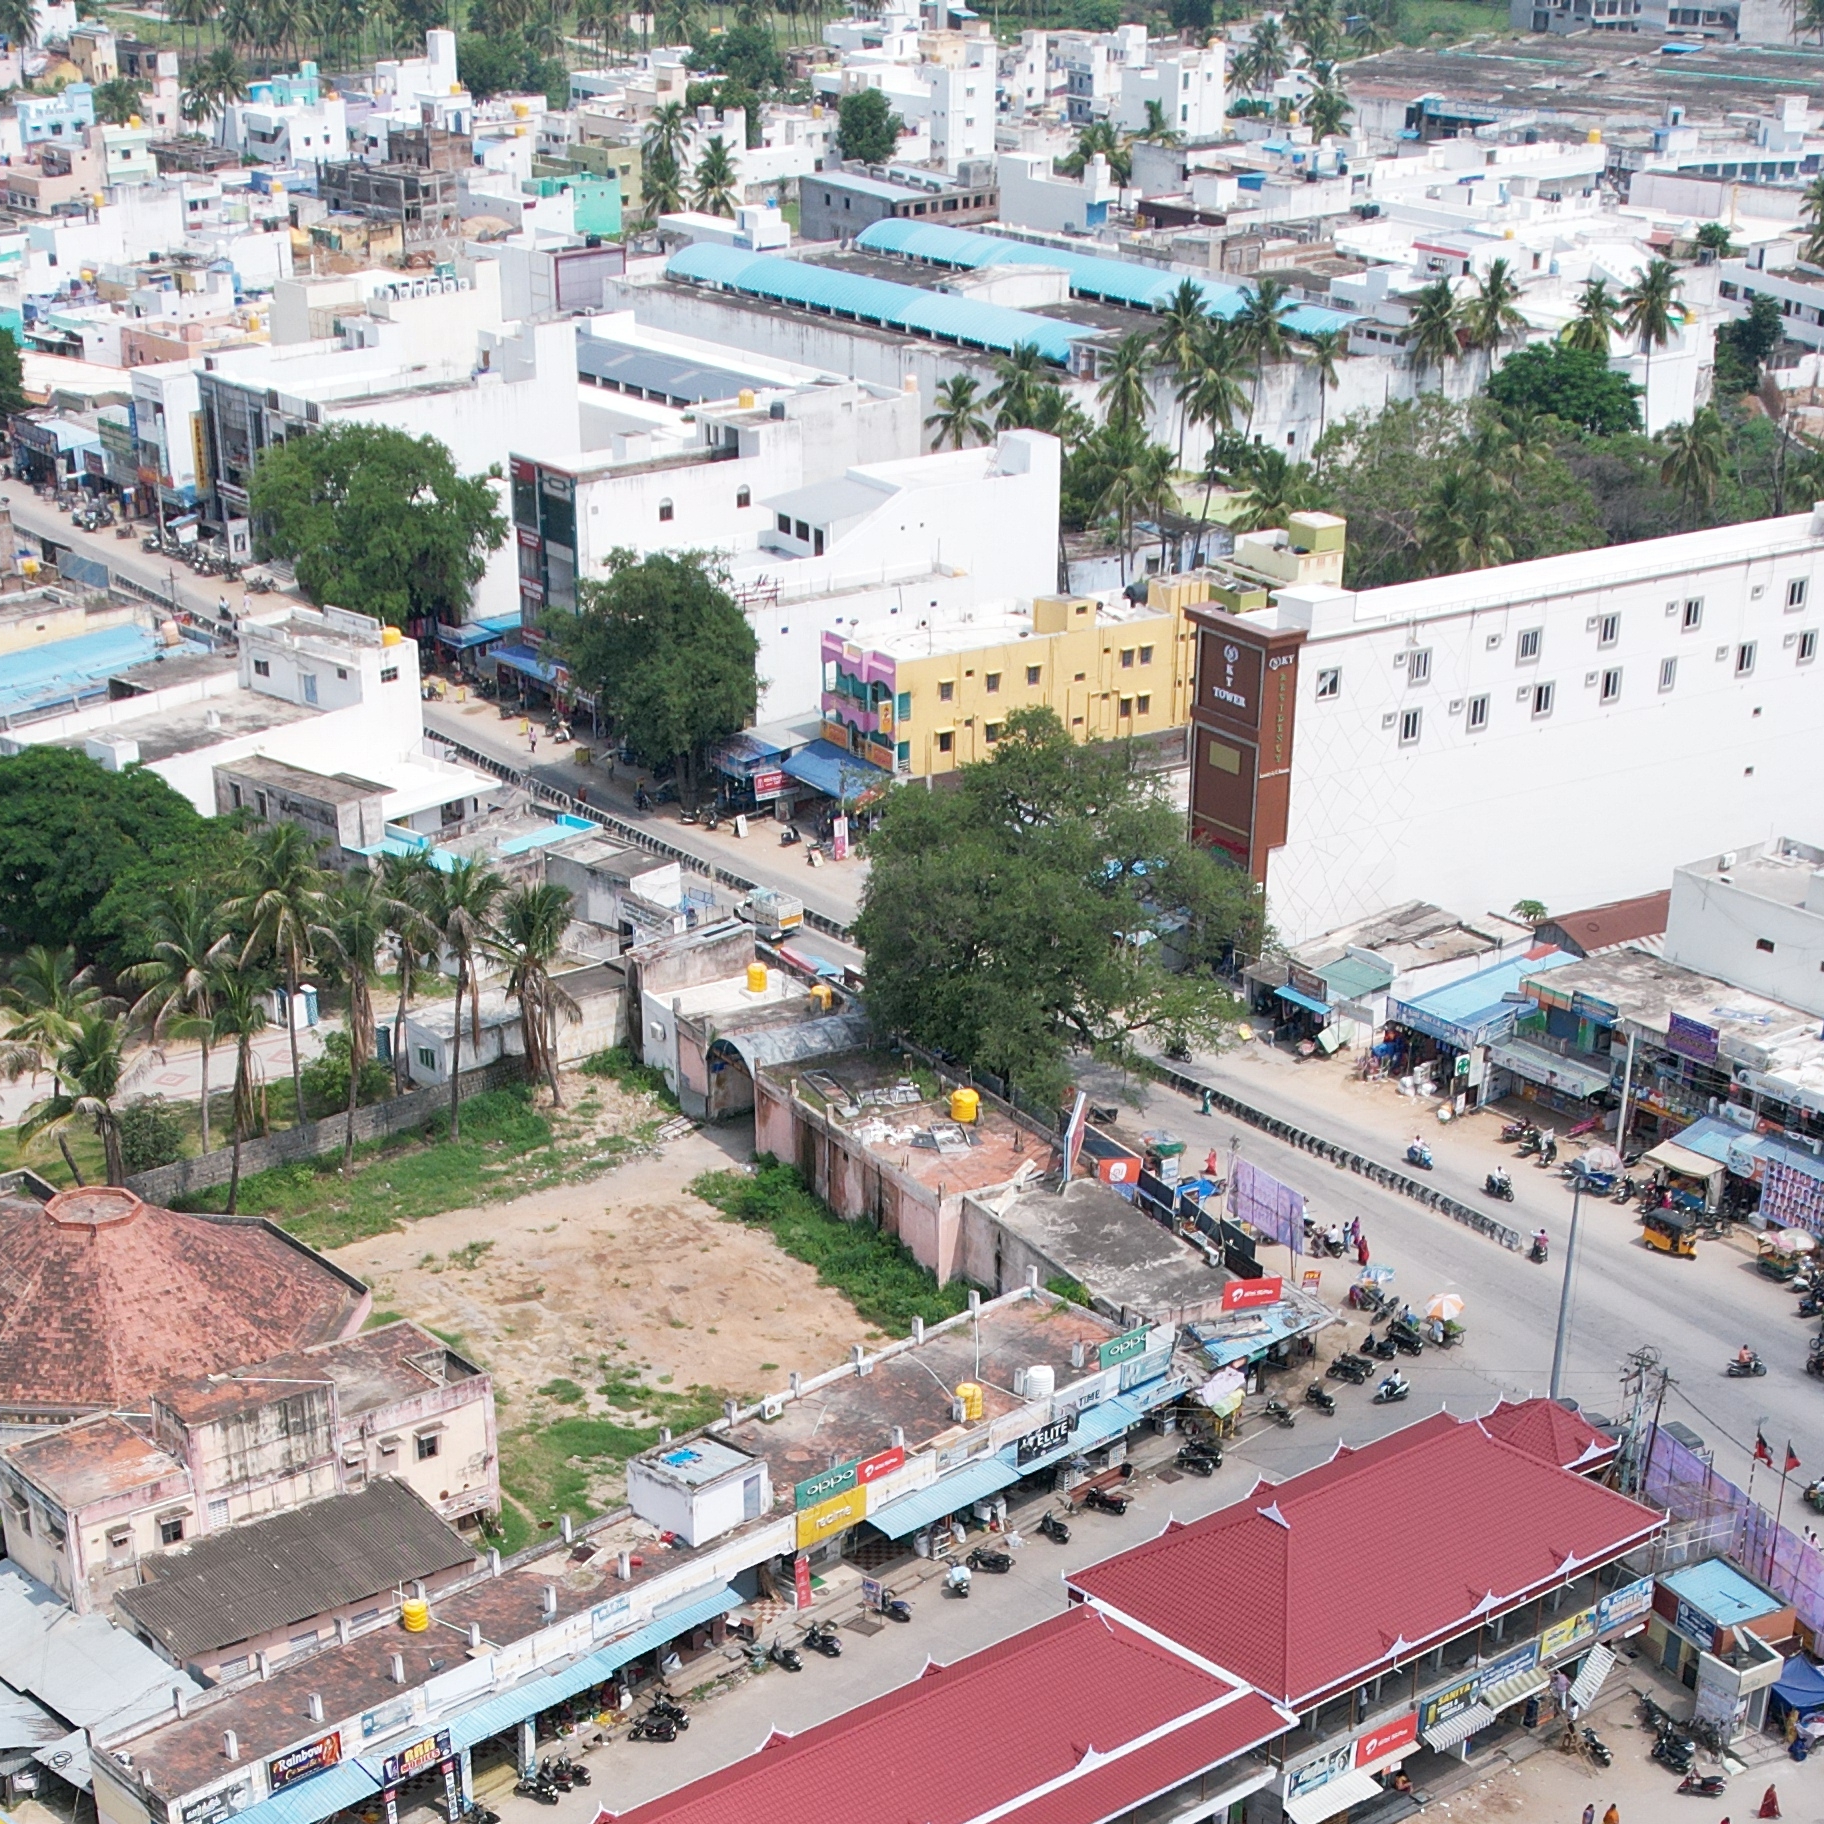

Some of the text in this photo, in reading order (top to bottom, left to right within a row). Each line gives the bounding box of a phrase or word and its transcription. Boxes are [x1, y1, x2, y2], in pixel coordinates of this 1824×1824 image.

[1212, 686, 1247, 708] TOWER
[1078, 1388, 1101, 1408] TIME
[1037, 1420, 1069, 1447] ELITE
[806, 1468, 855, 1496] oppo
[277, 1743, 324, 1772] Rainbow
[404, 1736, 437, 1764] RRR
